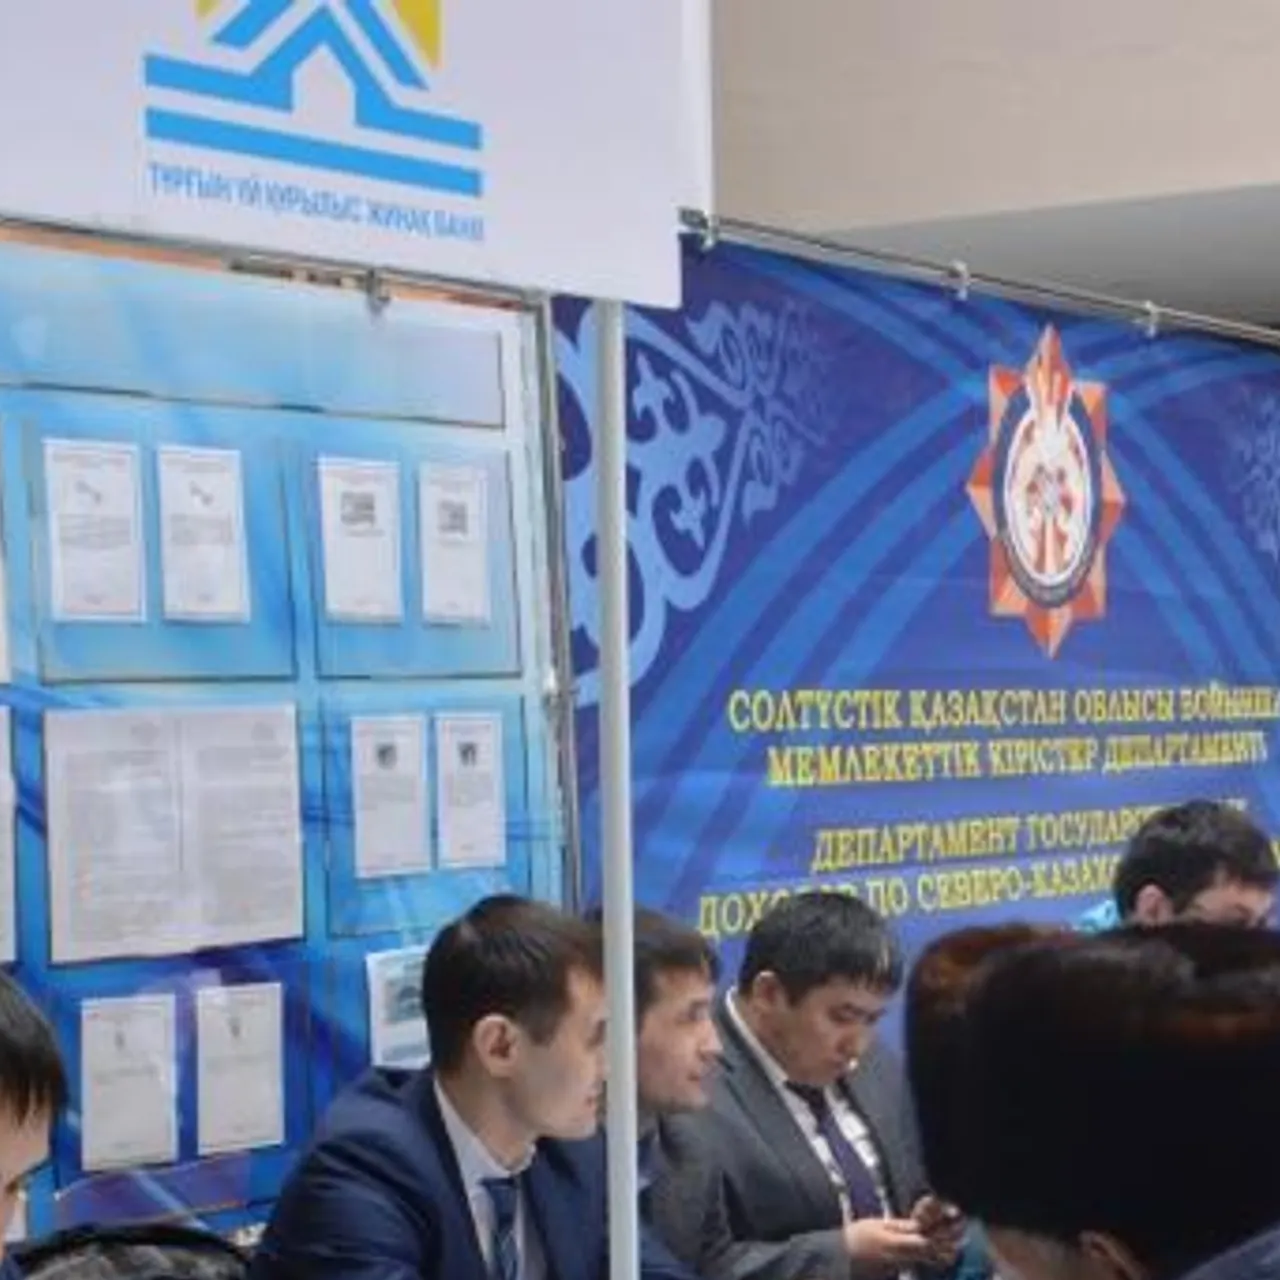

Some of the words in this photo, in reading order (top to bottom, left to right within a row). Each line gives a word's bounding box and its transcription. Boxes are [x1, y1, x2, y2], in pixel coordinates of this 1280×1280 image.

[909, 688, 1066, 734] ҚАЗАҚСТАН
[812, 817, 1020, 873] ДЕПАРТАМЕНТ
[866, 876, 909, 918] ПО
